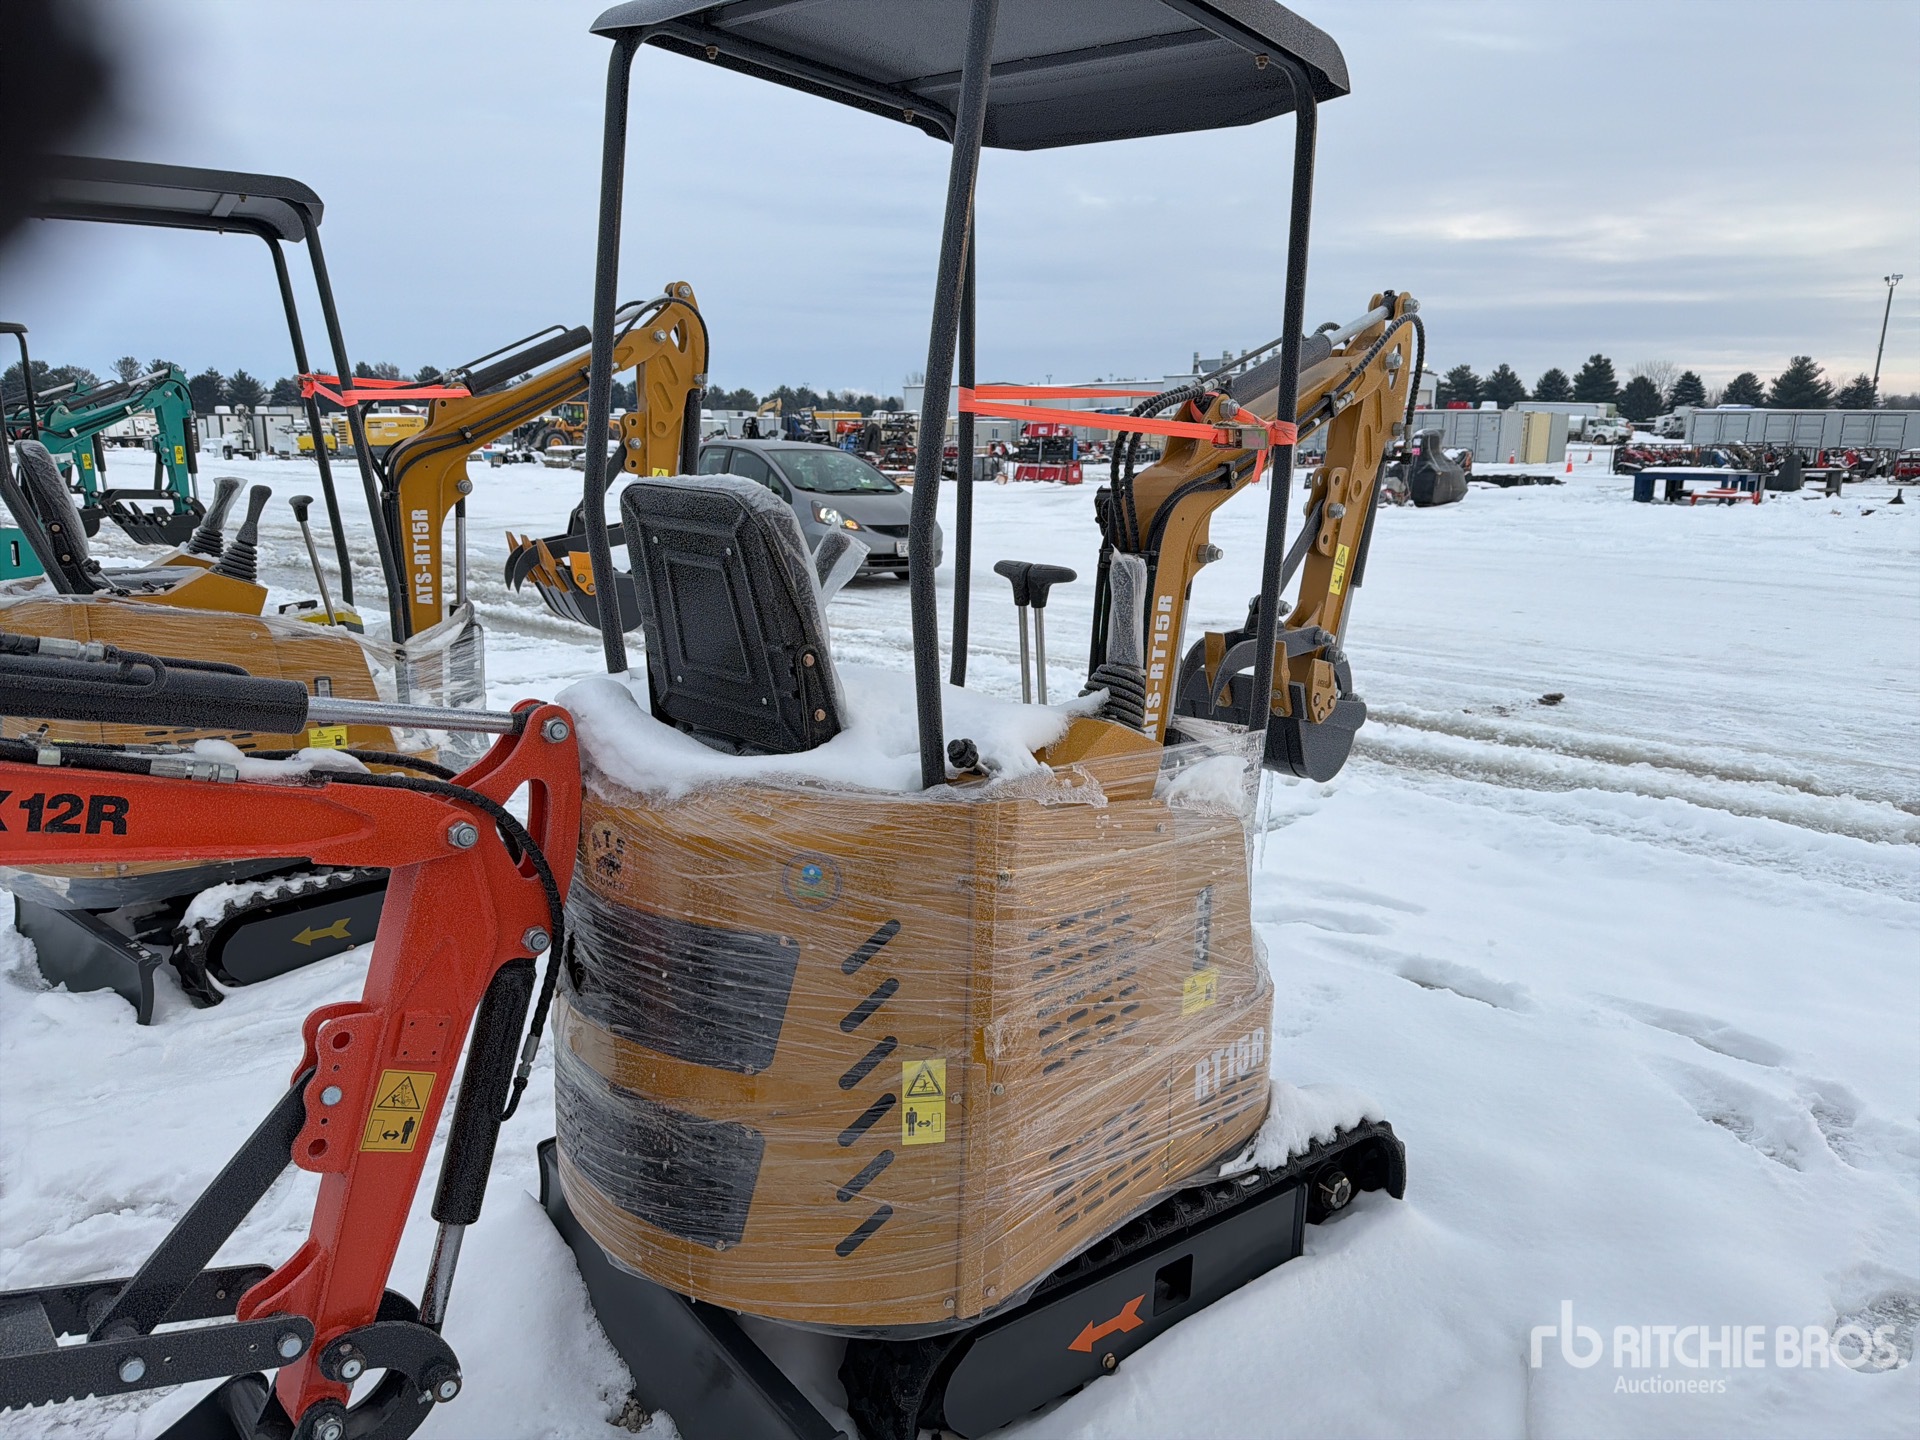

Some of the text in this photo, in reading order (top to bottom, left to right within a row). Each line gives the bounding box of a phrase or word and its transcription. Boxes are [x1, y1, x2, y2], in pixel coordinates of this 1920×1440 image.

[411, 509, 434, 605] ATS-RT15R
[1143, 595, 1173, 741] ATS-RT15R
[1195, 1026, 1265, 1101] RT15R
